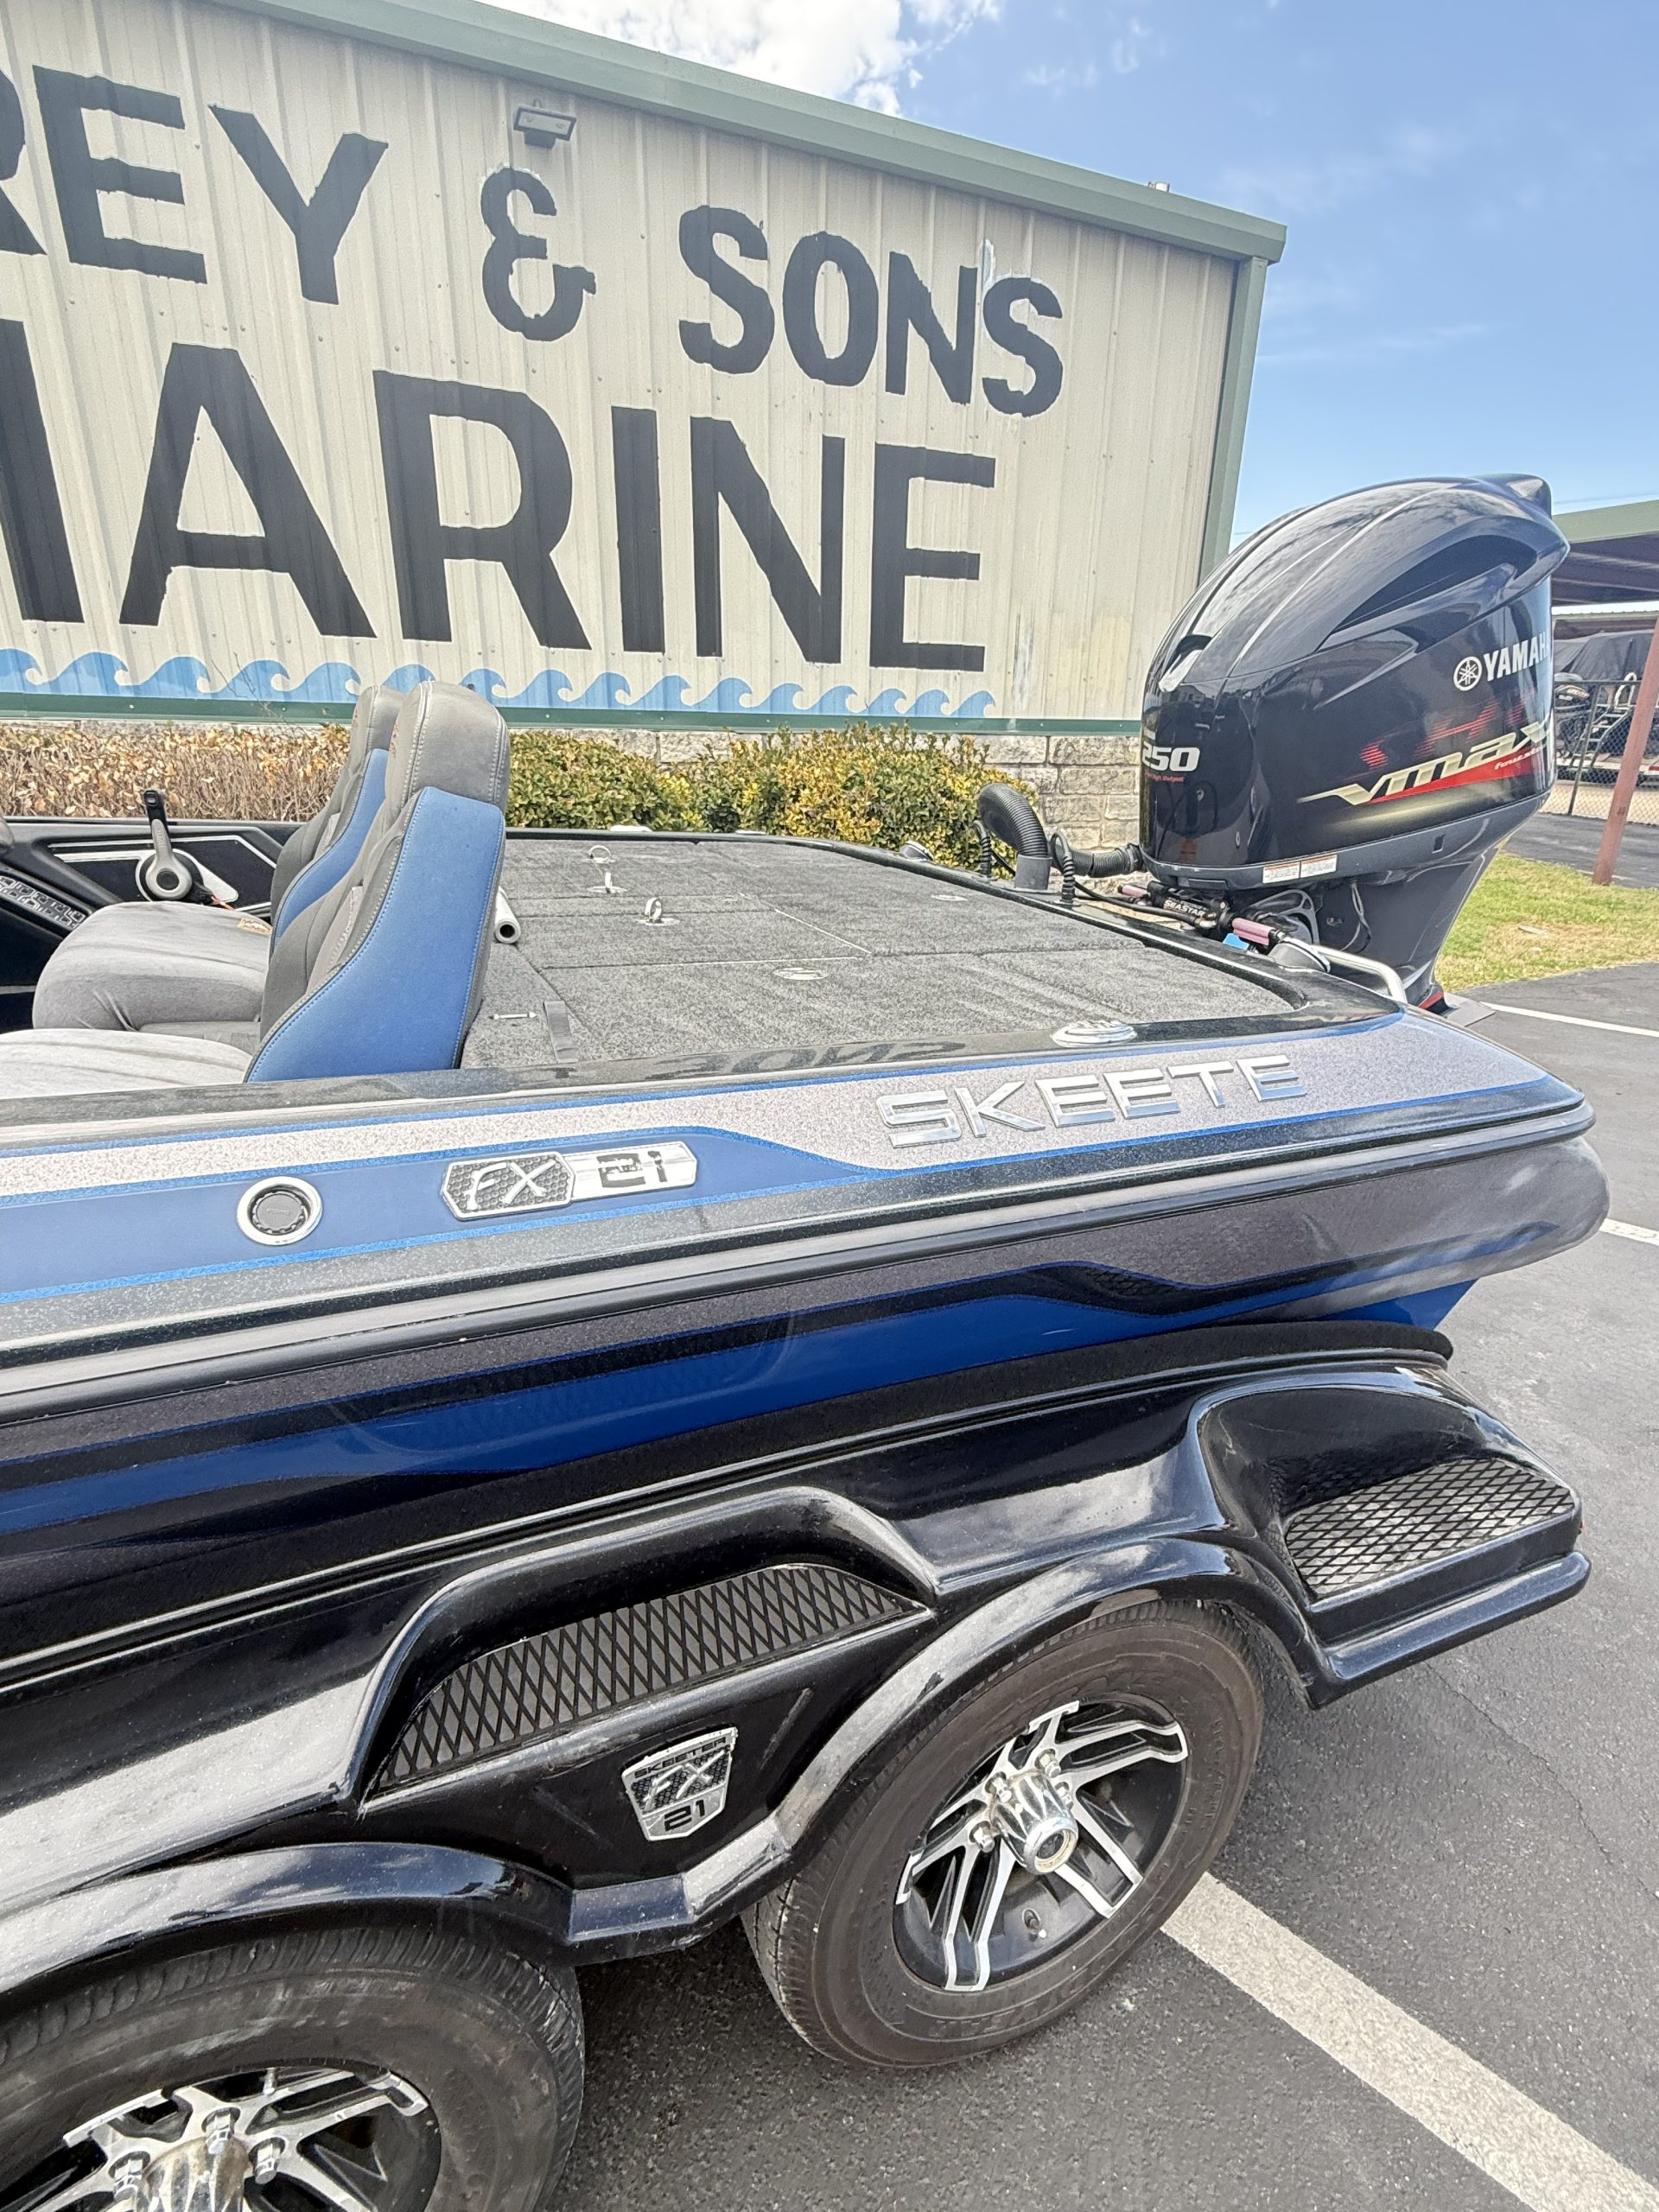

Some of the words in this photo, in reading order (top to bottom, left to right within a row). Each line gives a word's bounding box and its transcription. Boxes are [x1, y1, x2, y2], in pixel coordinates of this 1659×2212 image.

[480, 166, 596, 342] &
[678, 203, 1064, 417] SONS
[1483, 631, 1551, 682] YAMAH
[1141, 741, 1200, 772] 250
[876, 1054, 1307, 1149] SKEETE
[465, 1160, 557, 1211] FX
[634, 1736, 727, 1779] SKEETER
[642, 1749, 726, 1813] FX
[664, 1798, 706, 1833] 21
